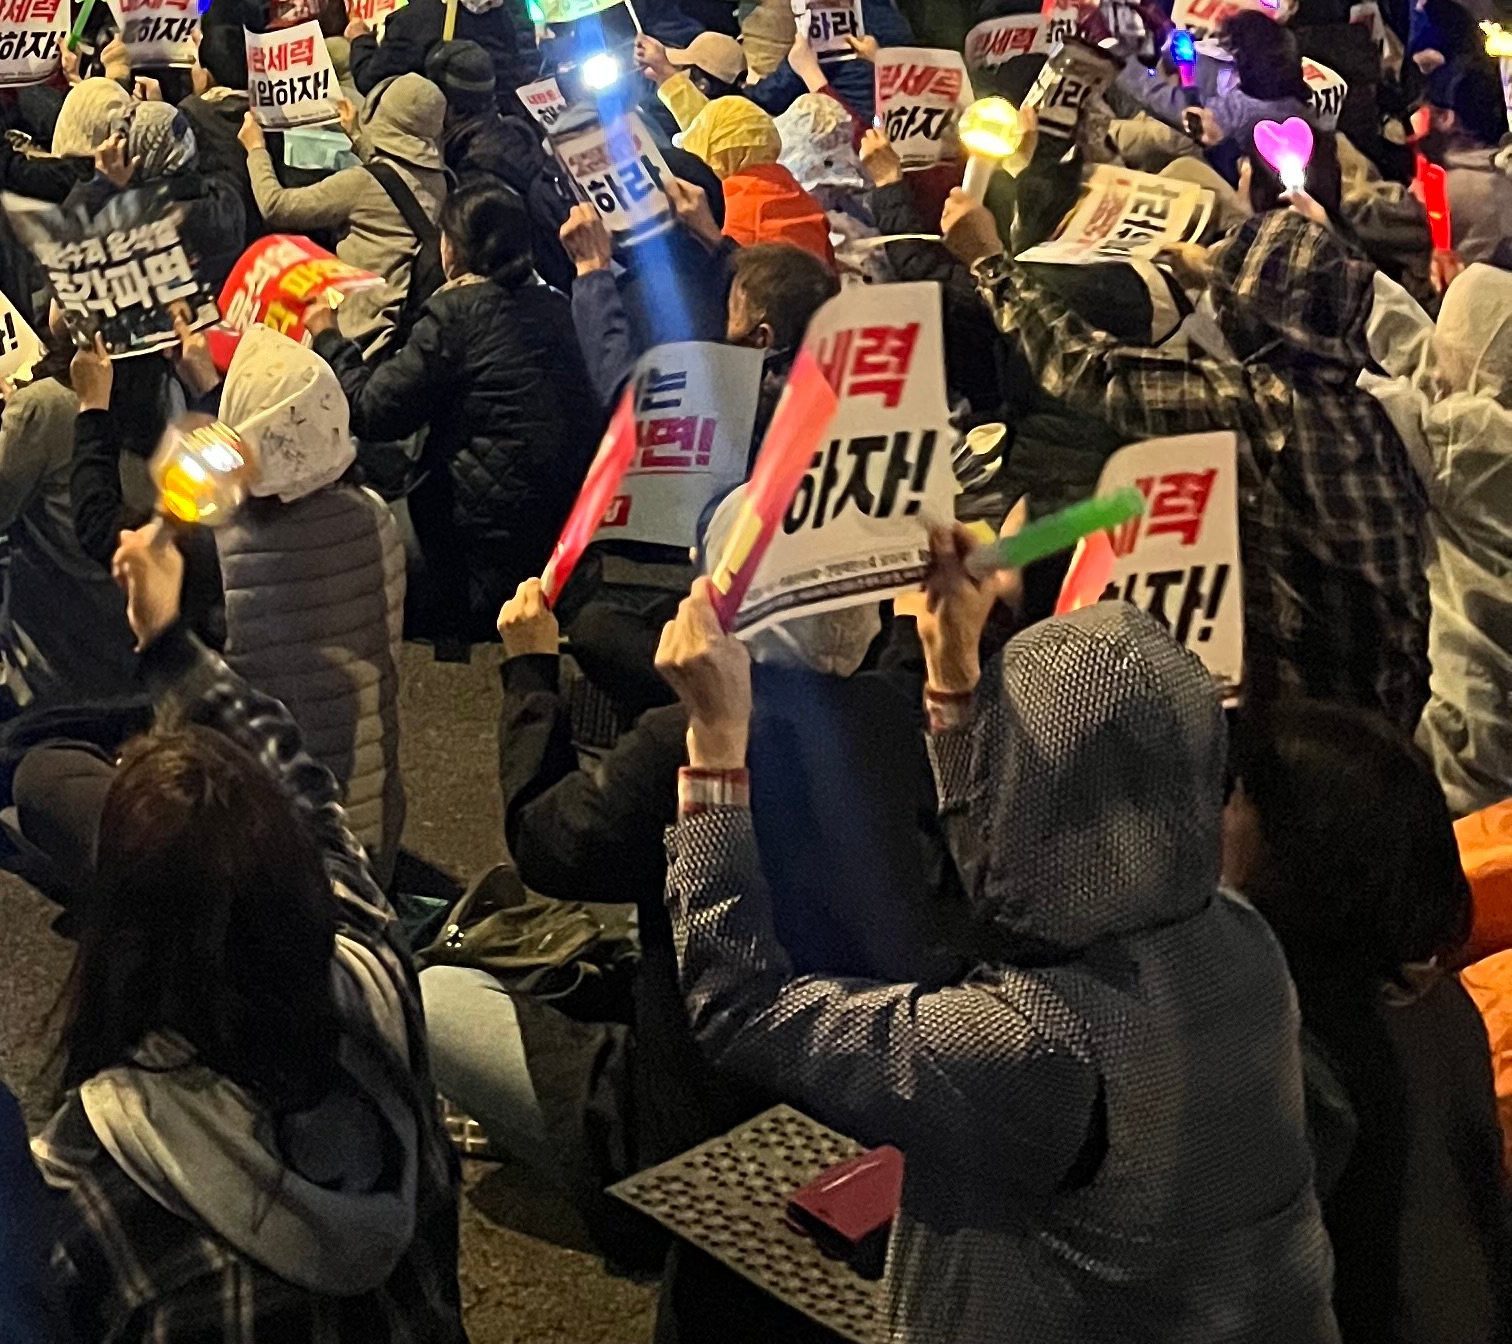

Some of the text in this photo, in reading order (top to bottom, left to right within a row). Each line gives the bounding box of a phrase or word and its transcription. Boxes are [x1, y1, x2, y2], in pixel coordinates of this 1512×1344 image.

[134, 16, 198, 45] 하자!
[809, 8, 859, 41] 하라
[249, 35, 315, 75] 란세력
[878, 62, 963, 103] 란세력
[588, 155, 665, 213] 하라
[815, 322, 921, 409] 세력
[636, 414, 717, 469] 면!
[781, 428, 938, 536] 하자!
